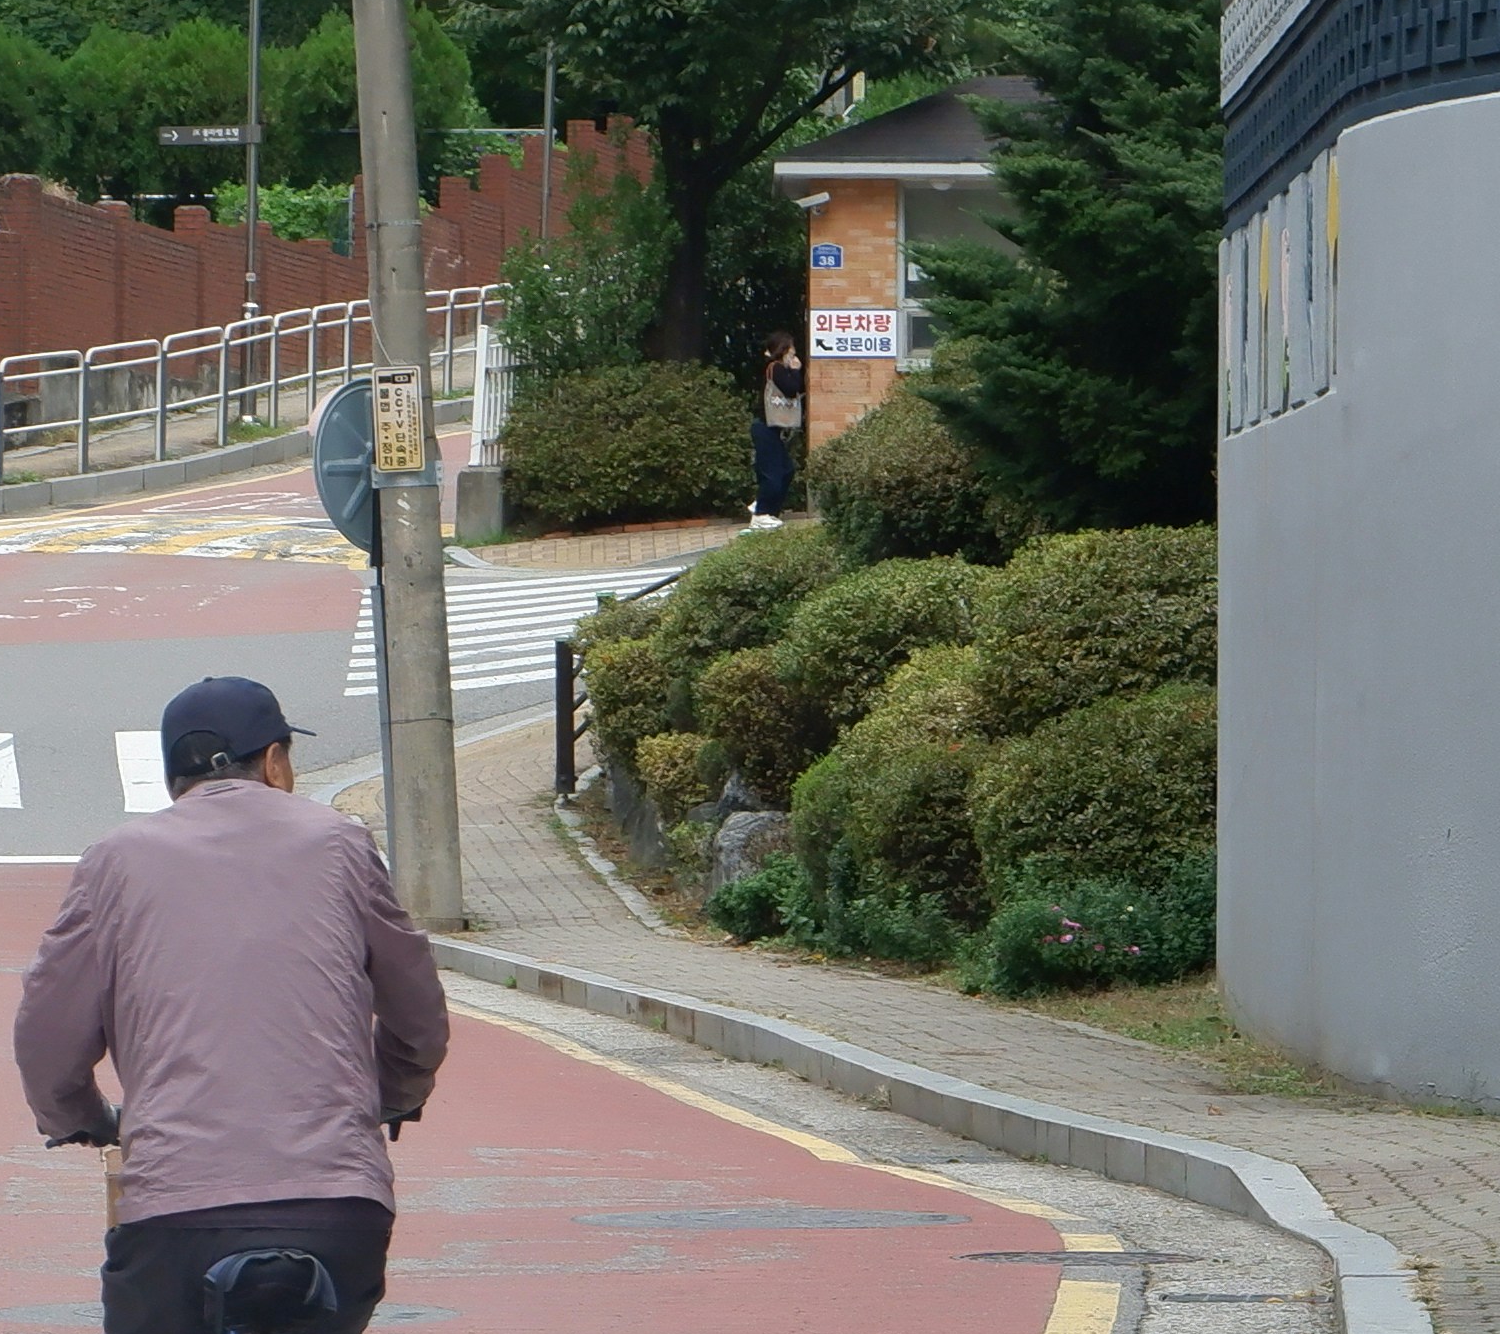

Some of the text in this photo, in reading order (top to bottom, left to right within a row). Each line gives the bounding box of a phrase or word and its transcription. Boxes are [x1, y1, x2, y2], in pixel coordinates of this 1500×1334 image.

[818, 255, 836, 266] 38
[815, 314, 892, 333] 외부차량
[835, 337, 892, 352] 정문이용
[394, 387, 404, 429] CCTV
